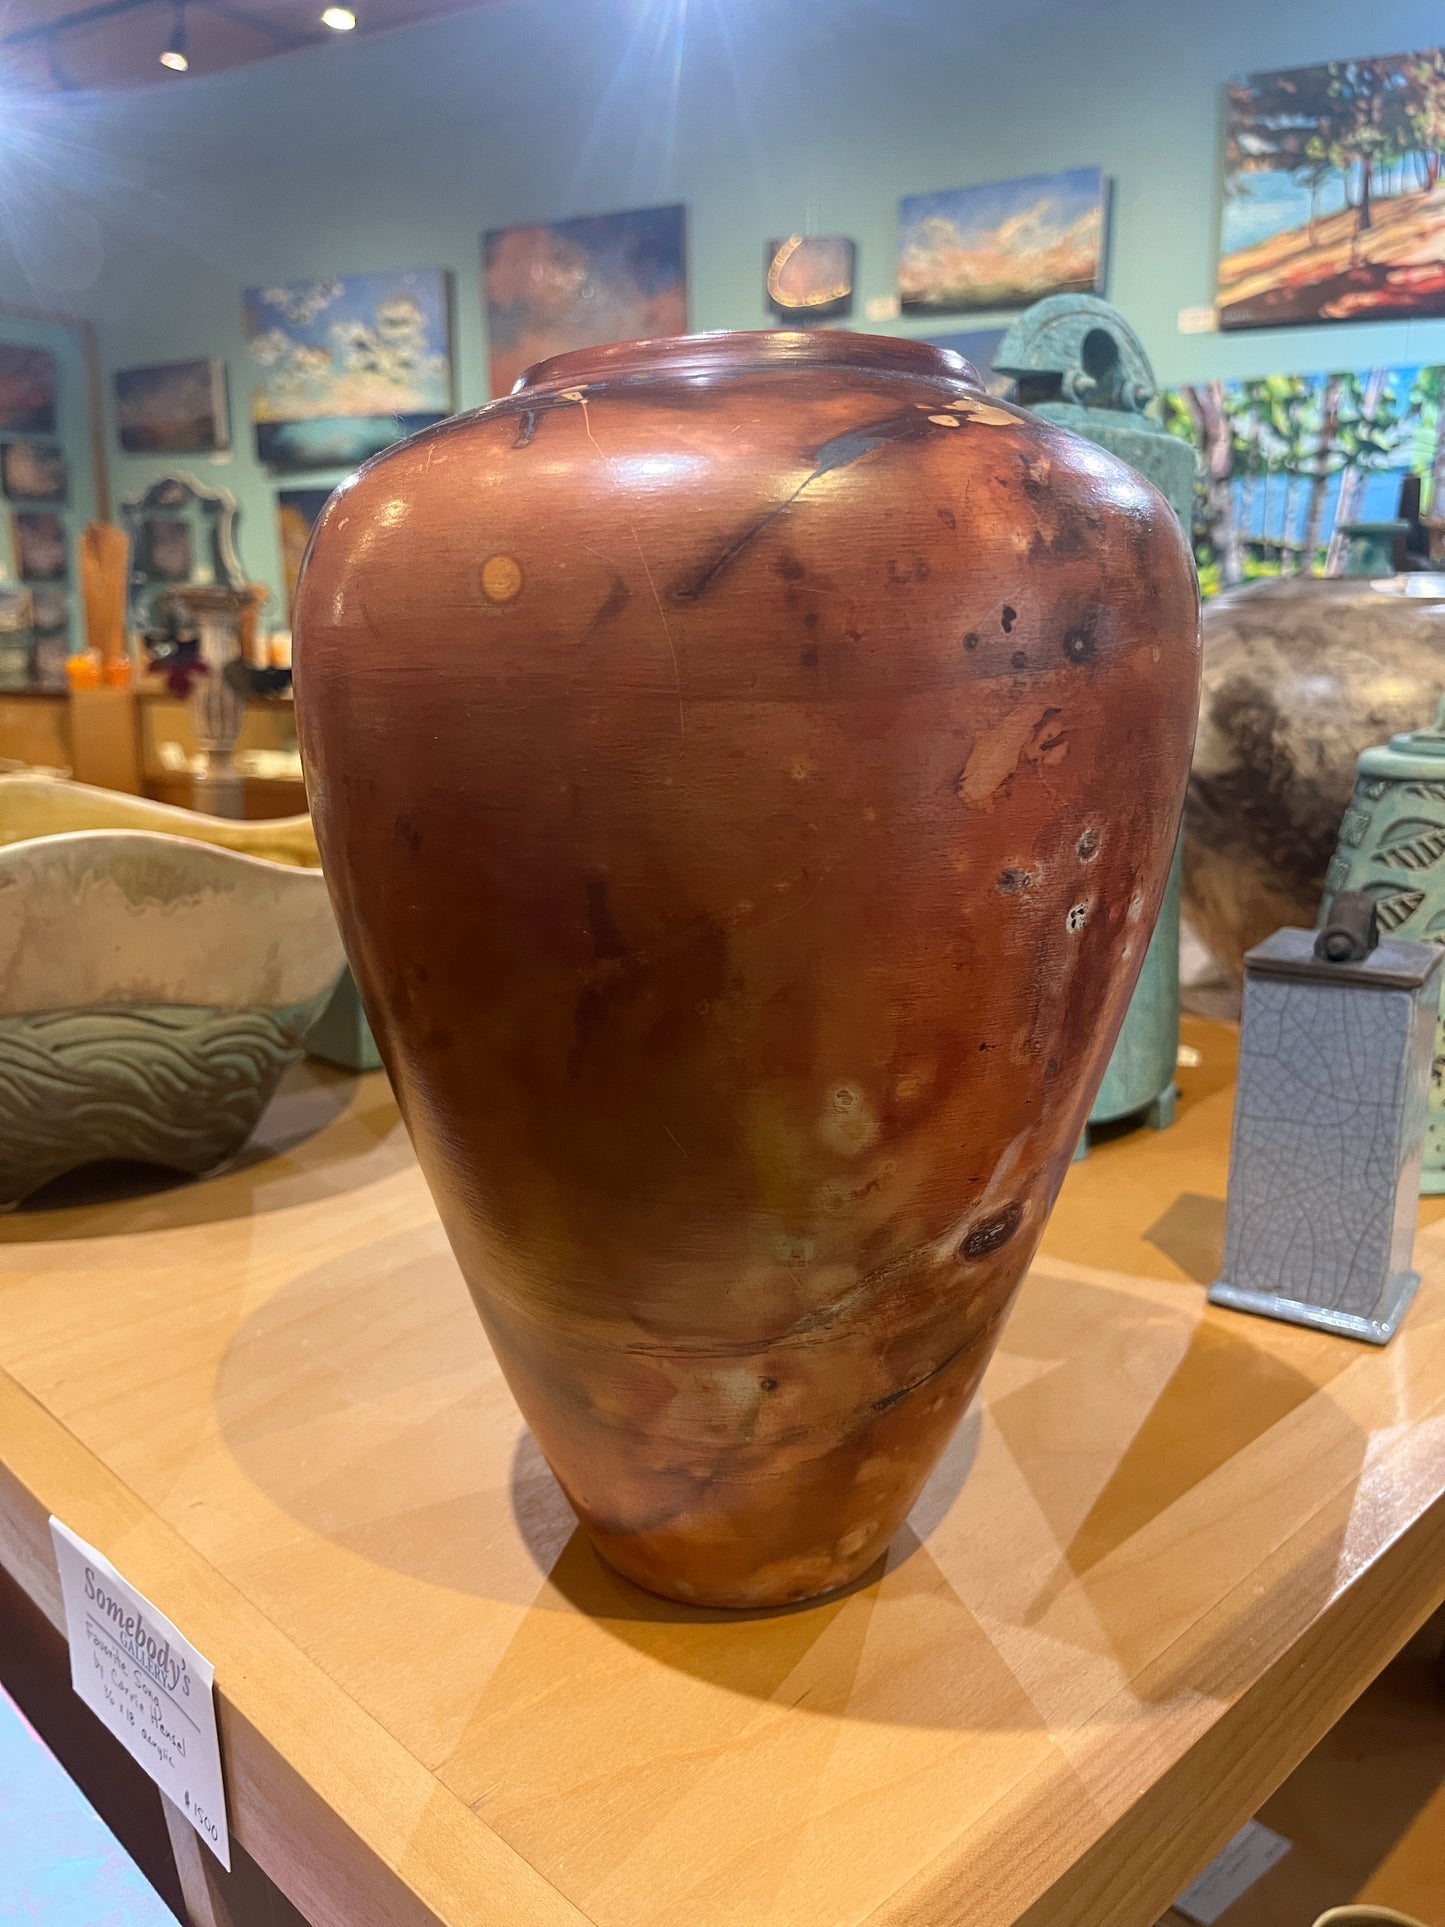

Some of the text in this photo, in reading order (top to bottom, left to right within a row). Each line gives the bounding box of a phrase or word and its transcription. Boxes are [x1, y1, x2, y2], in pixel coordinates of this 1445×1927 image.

[85, 1567, 191, 1697] Somebody's
[120, 1630, 168, 1689] GALLERY
[93, 1650, 104, 1680] by
